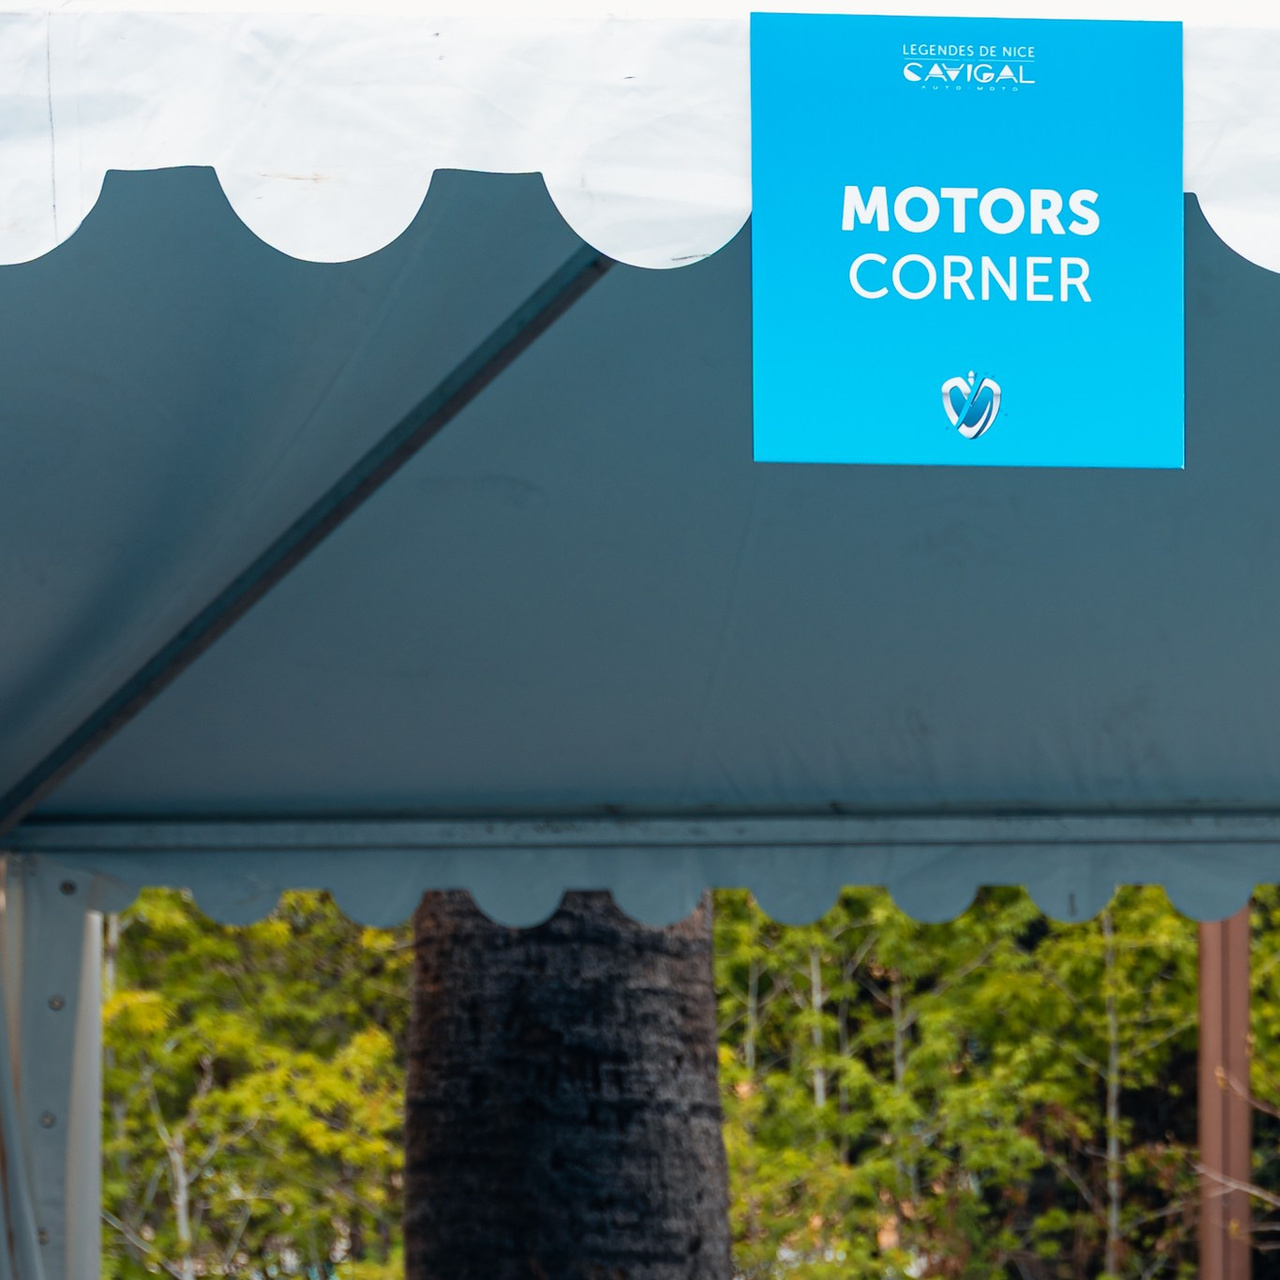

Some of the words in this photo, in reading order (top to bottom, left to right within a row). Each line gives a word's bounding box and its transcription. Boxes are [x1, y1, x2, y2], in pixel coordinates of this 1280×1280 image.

[902, 44, 974, 57] LEGENDES
[979, 45, 997, 57] DE
[1002, 46, 1035, 58] NICE
[903, 62, 1036, 84] CAVIGAL
[842, 185, 1100, 236] MOTORS
[848, 252, 1092, 302] CORNER
